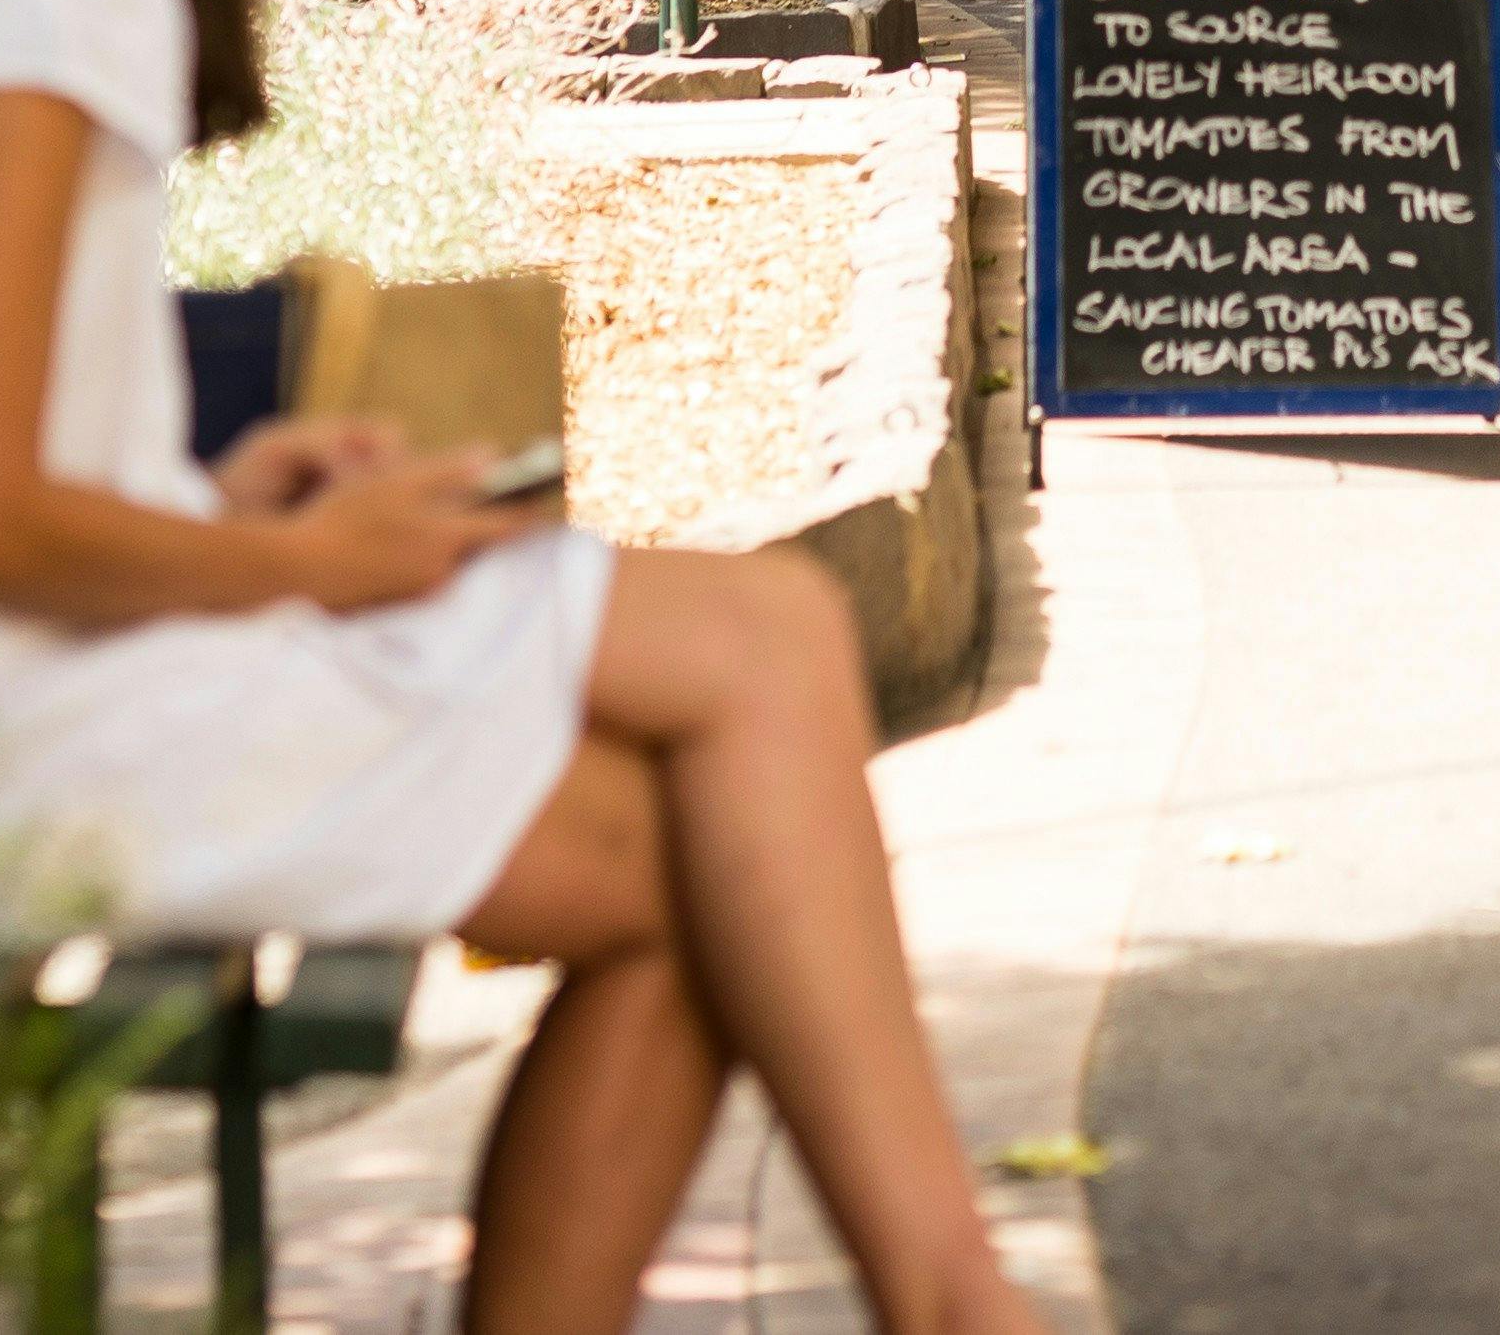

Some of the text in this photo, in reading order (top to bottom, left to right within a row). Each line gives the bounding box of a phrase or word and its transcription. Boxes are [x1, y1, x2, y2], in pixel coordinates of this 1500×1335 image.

[1094, 10, 1340, 51] TO SOURCE
[1073, 58, 1456, 110] LOVELY HEIRLOOM
[1074, 118, 1461, 171] TOMATOES FROM
[1082, 170, 1476, 225] GROWERS IN THE
[1087, 236, 1239, 274] LOCAL
[1242, 237, 1369, 275] AREA
[1254, 294, 1473, 338] TOMATOES
[1407, 338, 1500, 383] ASK
